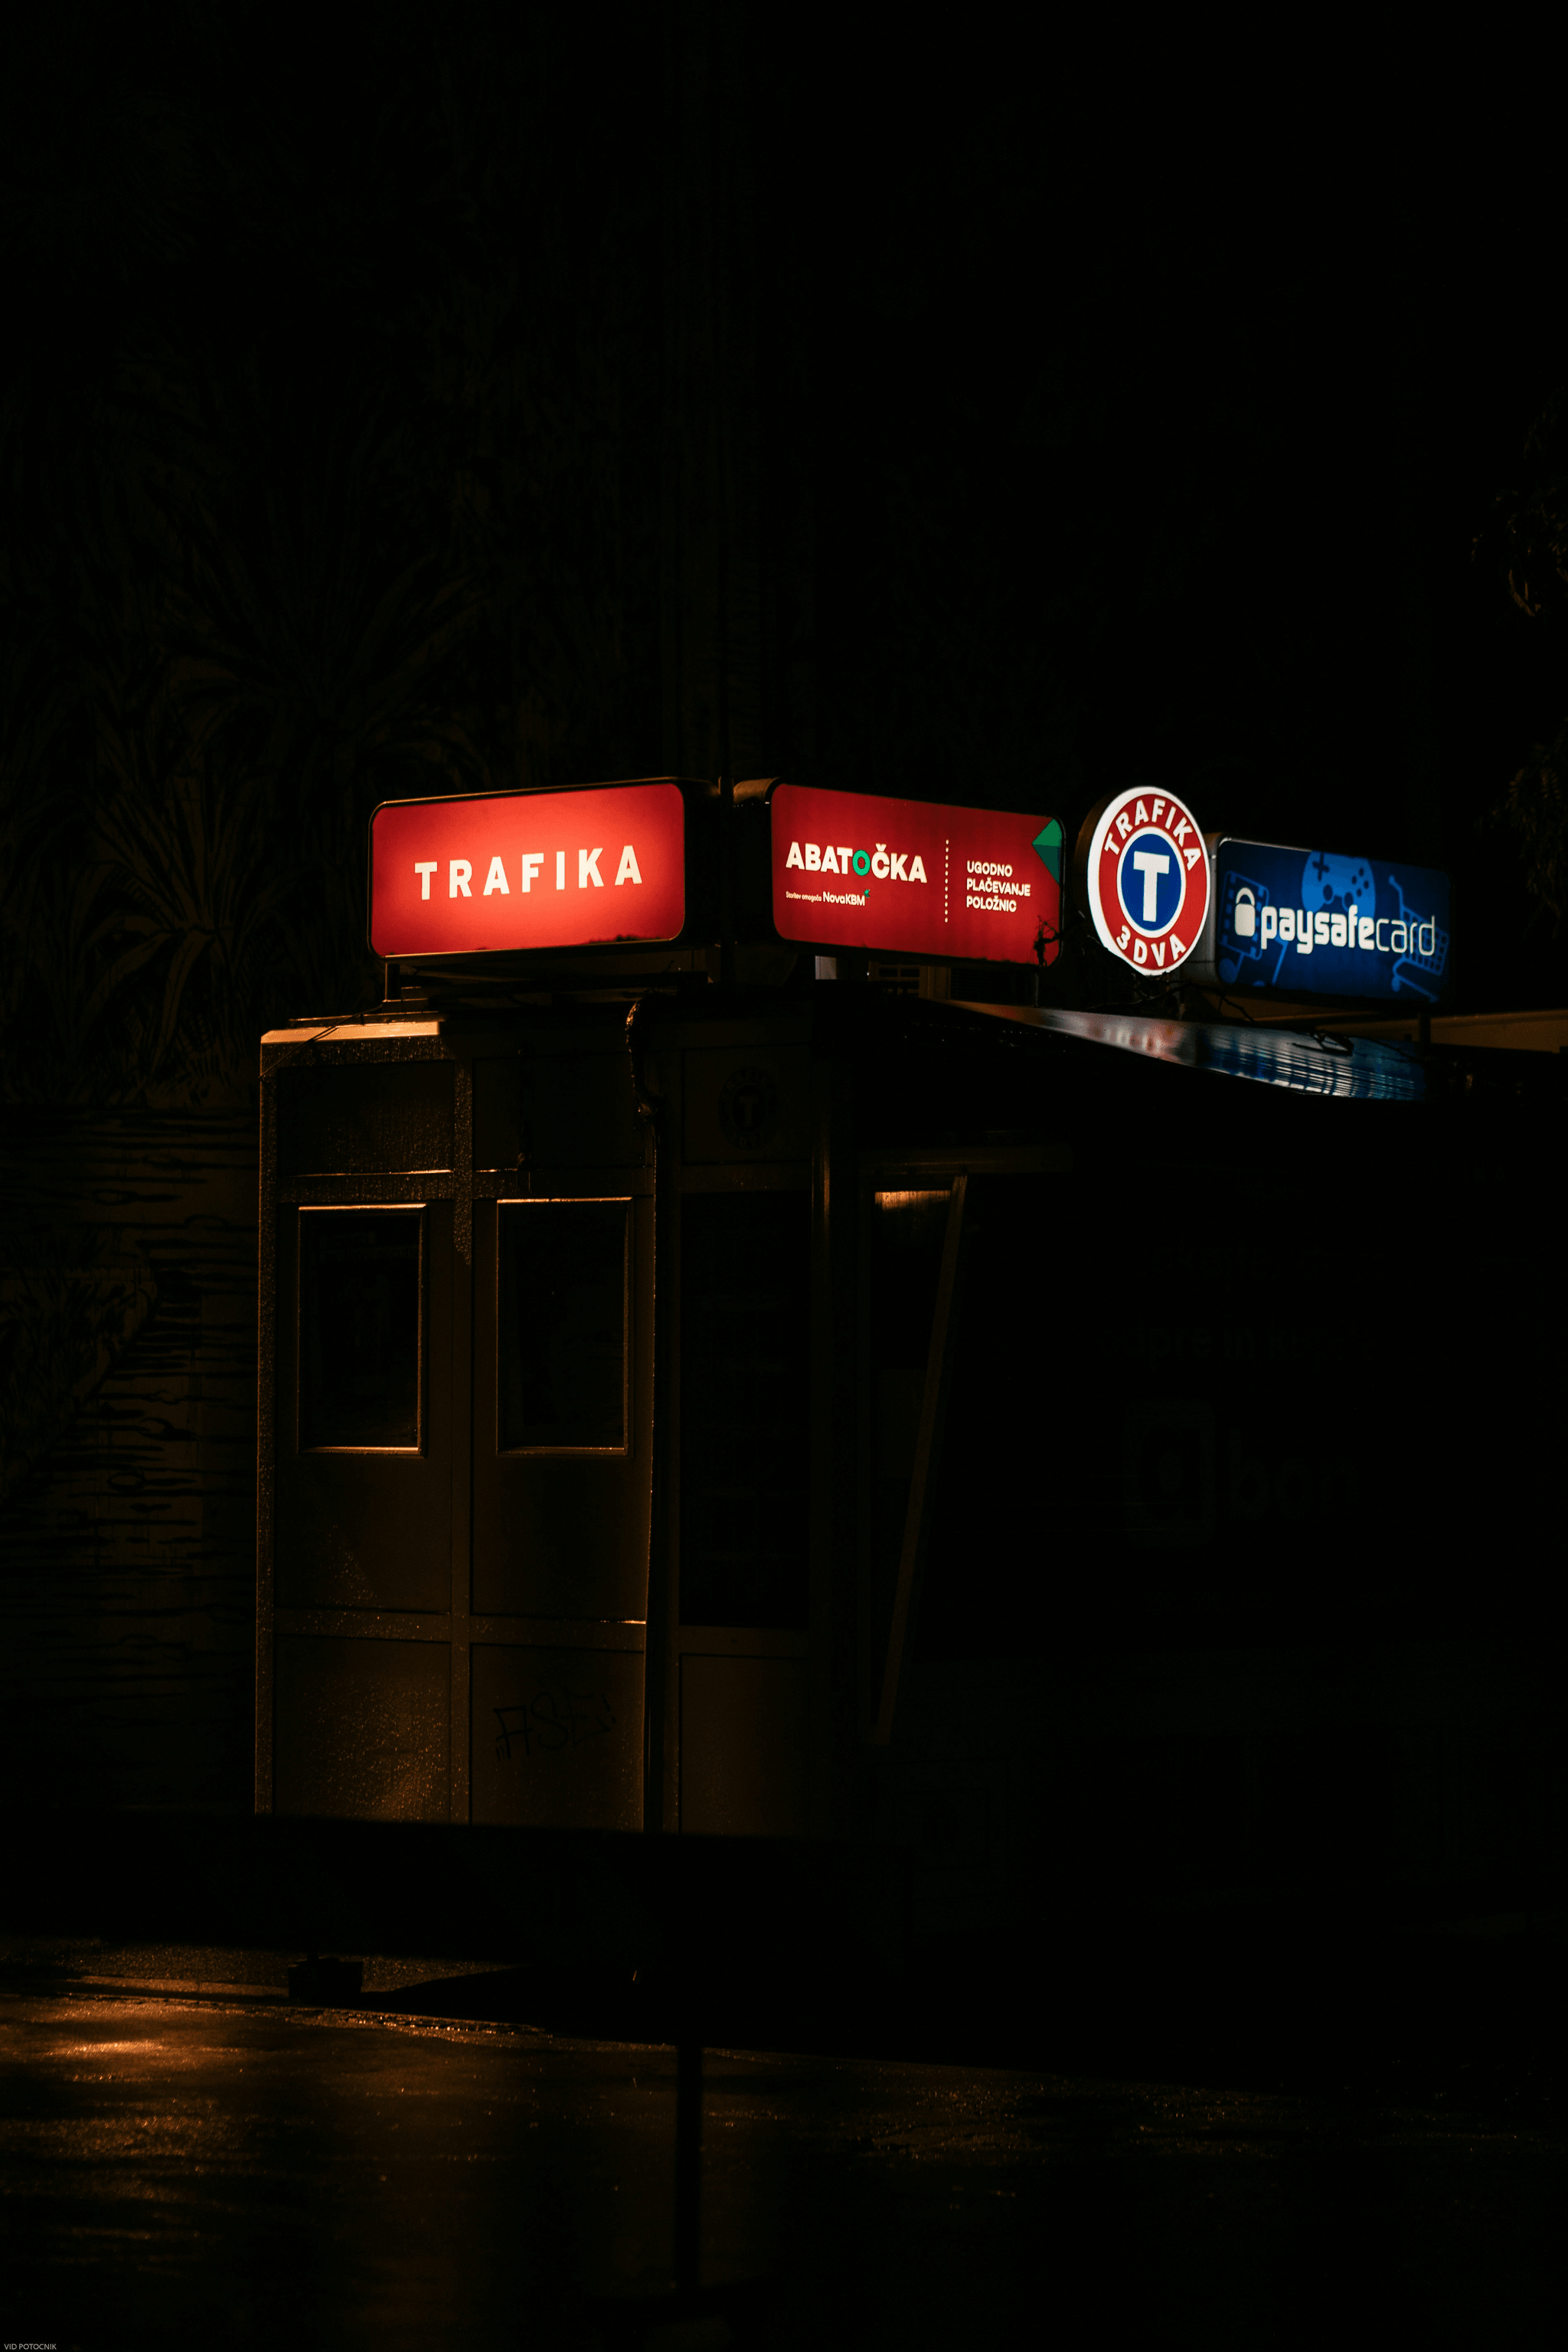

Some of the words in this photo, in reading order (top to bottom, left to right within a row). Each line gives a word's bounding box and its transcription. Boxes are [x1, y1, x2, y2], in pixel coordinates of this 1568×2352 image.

[1104, 799, 1202, 871] TRAFIKA
[414, 845, 642, 900] TRAFIKA
[786, 842, 927, 883] ABATOČKA
[966, 861, 1013, 877] UGODNO
[823, 891, 865, 906] NovaKBM
[966, 877, 1031, 897] PLAČEVANJE
[966, 896, 1017, 913] POLOŽNIC
[1133, 851, 1170, 922] T
[1116, 925, 1187, 967] 3DVA
[1260, 904, 1435, 956] paysafecard
